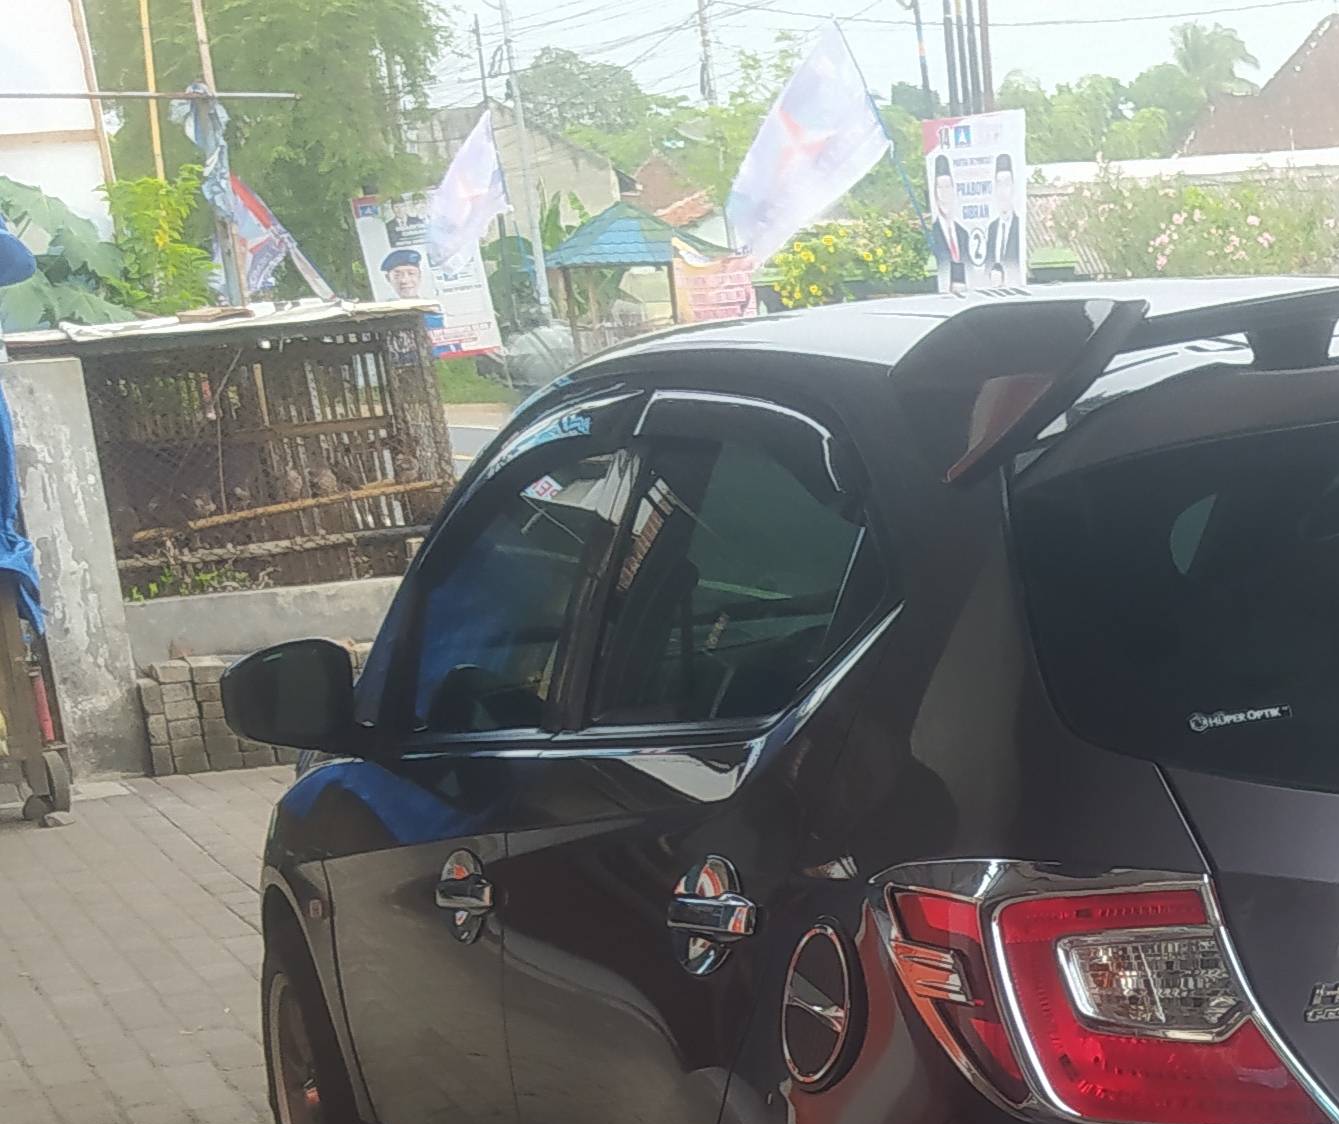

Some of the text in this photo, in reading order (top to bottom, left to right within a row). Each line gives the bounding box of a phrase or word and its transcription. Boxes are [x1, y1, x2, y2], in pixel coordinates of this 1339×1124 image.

[939, 128, 950, 149] 14
[956, 180, 993, 196] PRABOWO
[974, 233, 983, 260] 2
[1246, 707, 1282, 720] OPTIK
